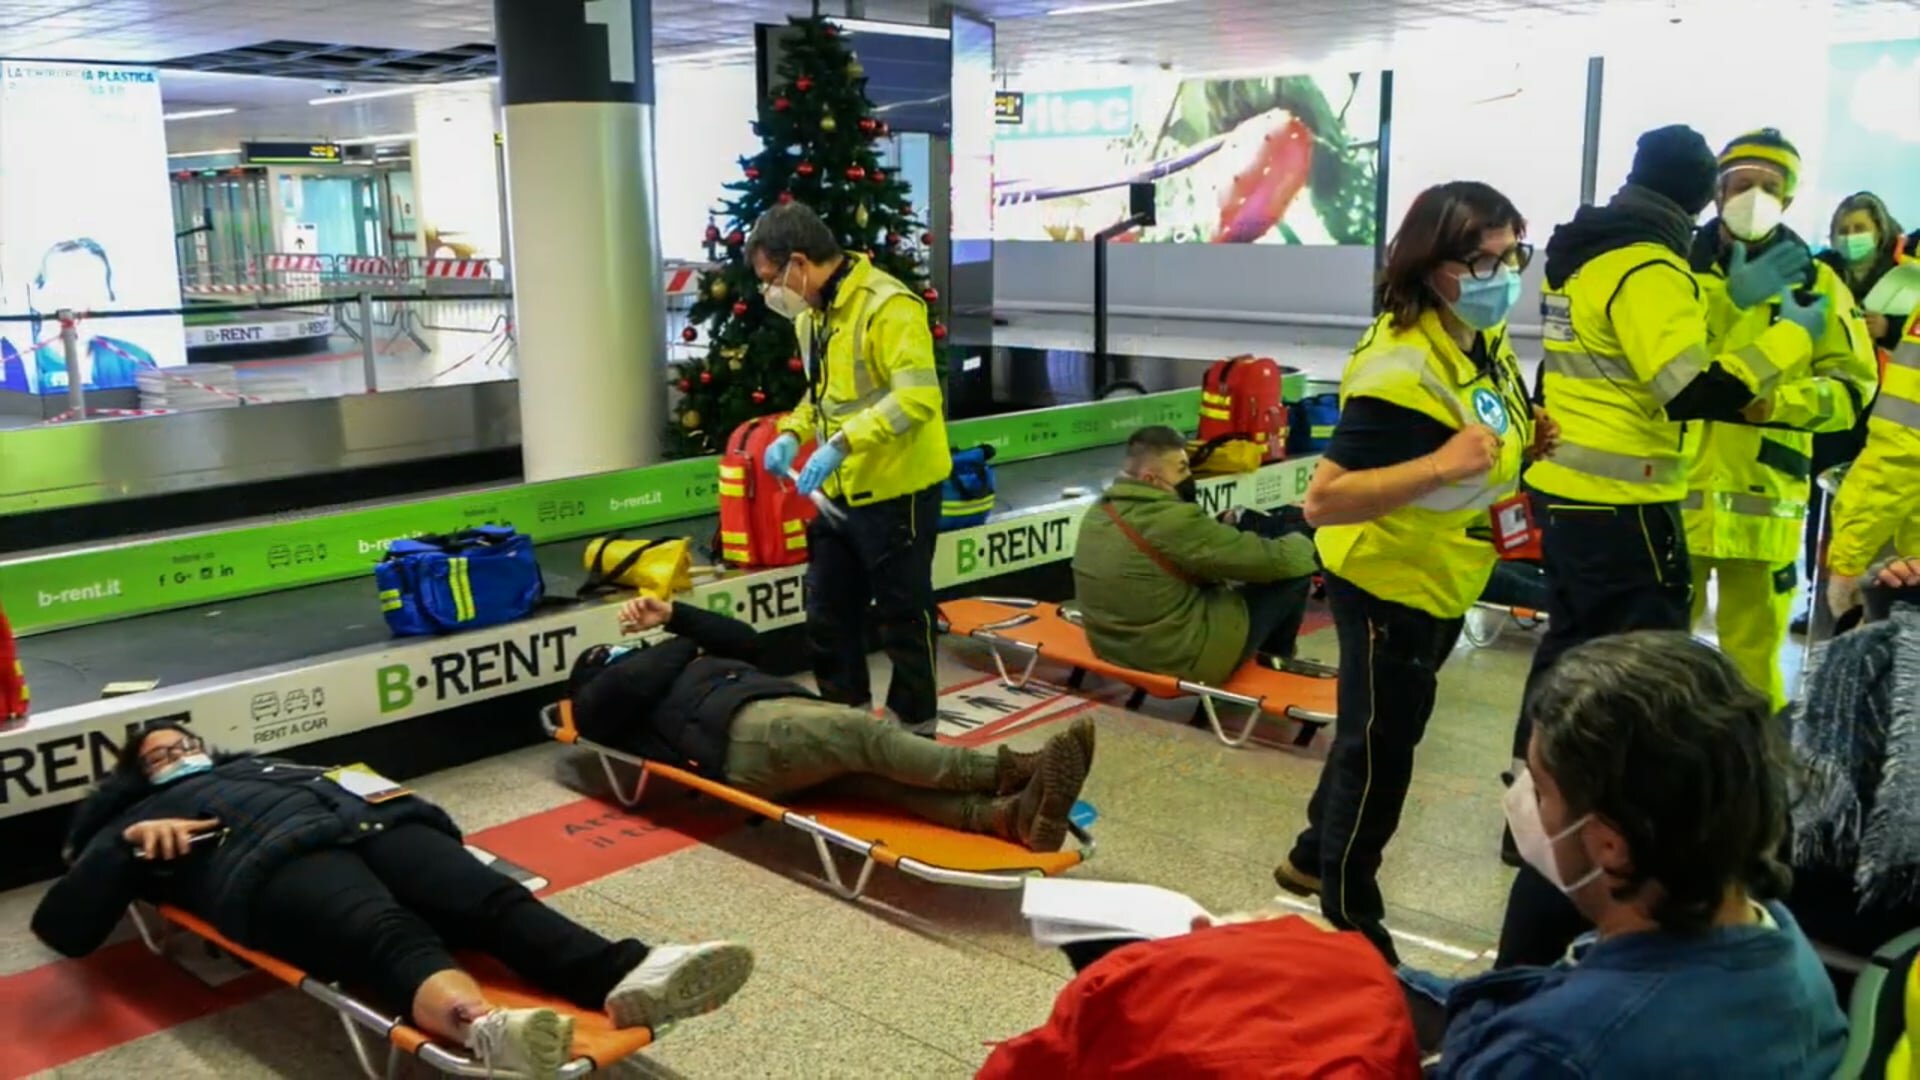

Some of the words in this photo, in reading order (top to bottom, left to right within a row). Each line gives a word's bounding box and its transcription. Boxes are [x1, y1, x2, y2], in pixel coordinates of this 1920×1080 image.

[584, 0, 635, 83] 1
[8, 67, 22, 78] LA
[98, 71, 155, 83] PLASTICA
[38, 579, 121, 607] b-rent.it
[254, 726, 288, 744] RENT
[290, 723, 300, 735] A
[301, 717, 329, 732] CAR
